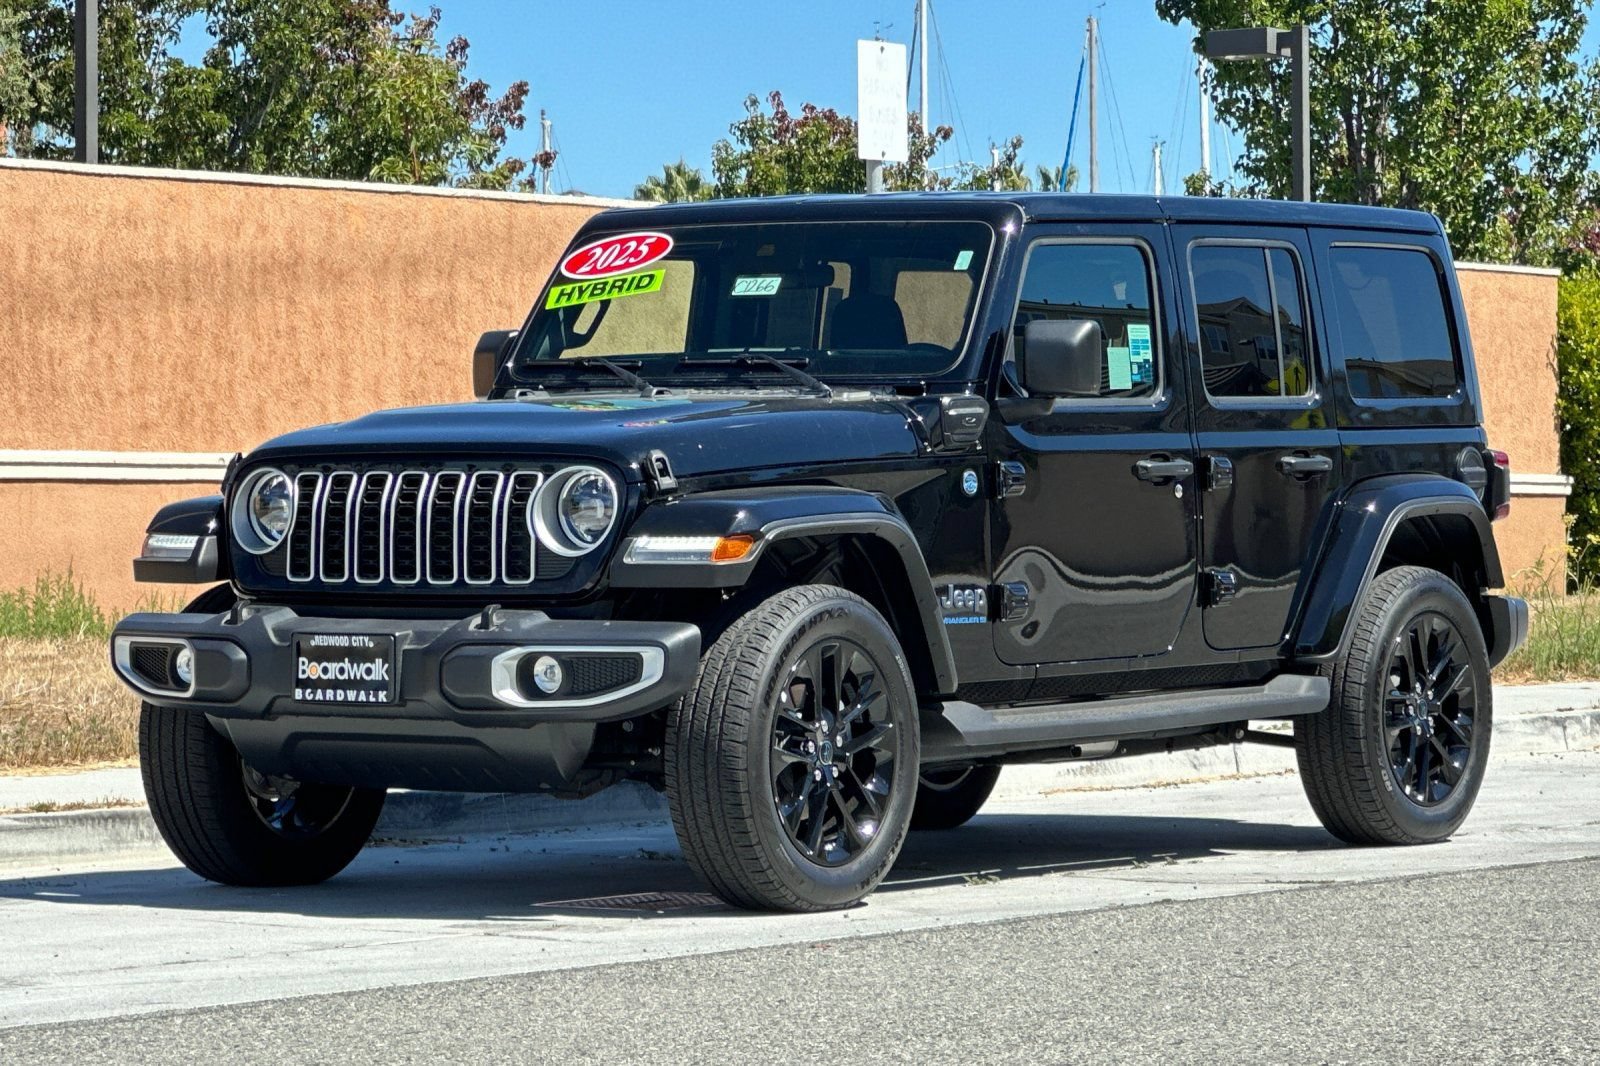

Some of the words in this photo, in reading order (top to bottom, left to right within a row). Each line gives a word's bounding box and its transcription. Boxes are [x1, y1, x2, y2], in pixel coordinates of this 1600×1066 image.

[575, 237, 658, 274] 2025
[554, 273, 656, 304] HYBRID
[941, 583, 988, 616] Jeep
[314, 635, 349, 646] REDWOOD
[351, 636, 370, 647] CITY
[298, 656, 389, 681] Boardwalk
